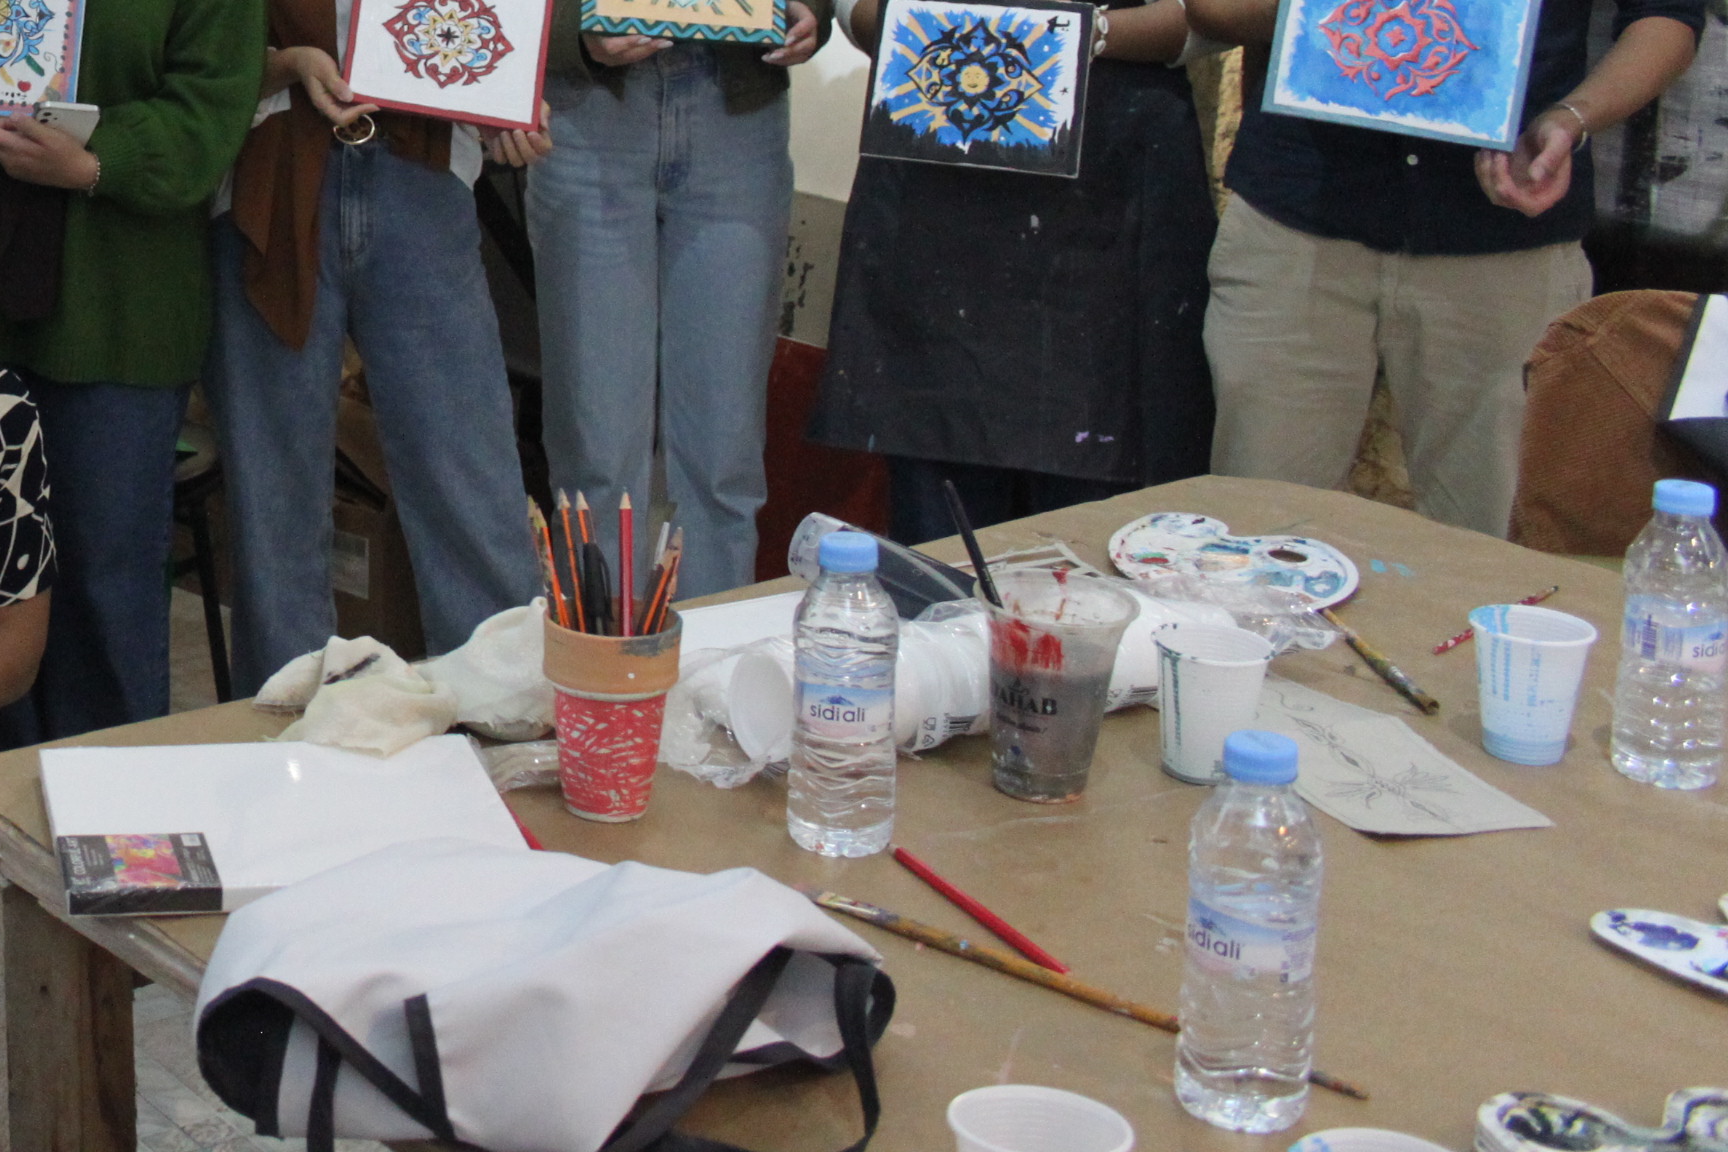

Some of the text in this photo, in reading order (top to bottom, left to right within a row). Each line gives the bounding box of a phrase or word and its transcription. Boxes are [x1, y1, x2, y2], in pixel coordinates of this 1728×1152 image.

[810, 704, 866, 723] sidi ali
[1213, 940, 1240, 961] ali
